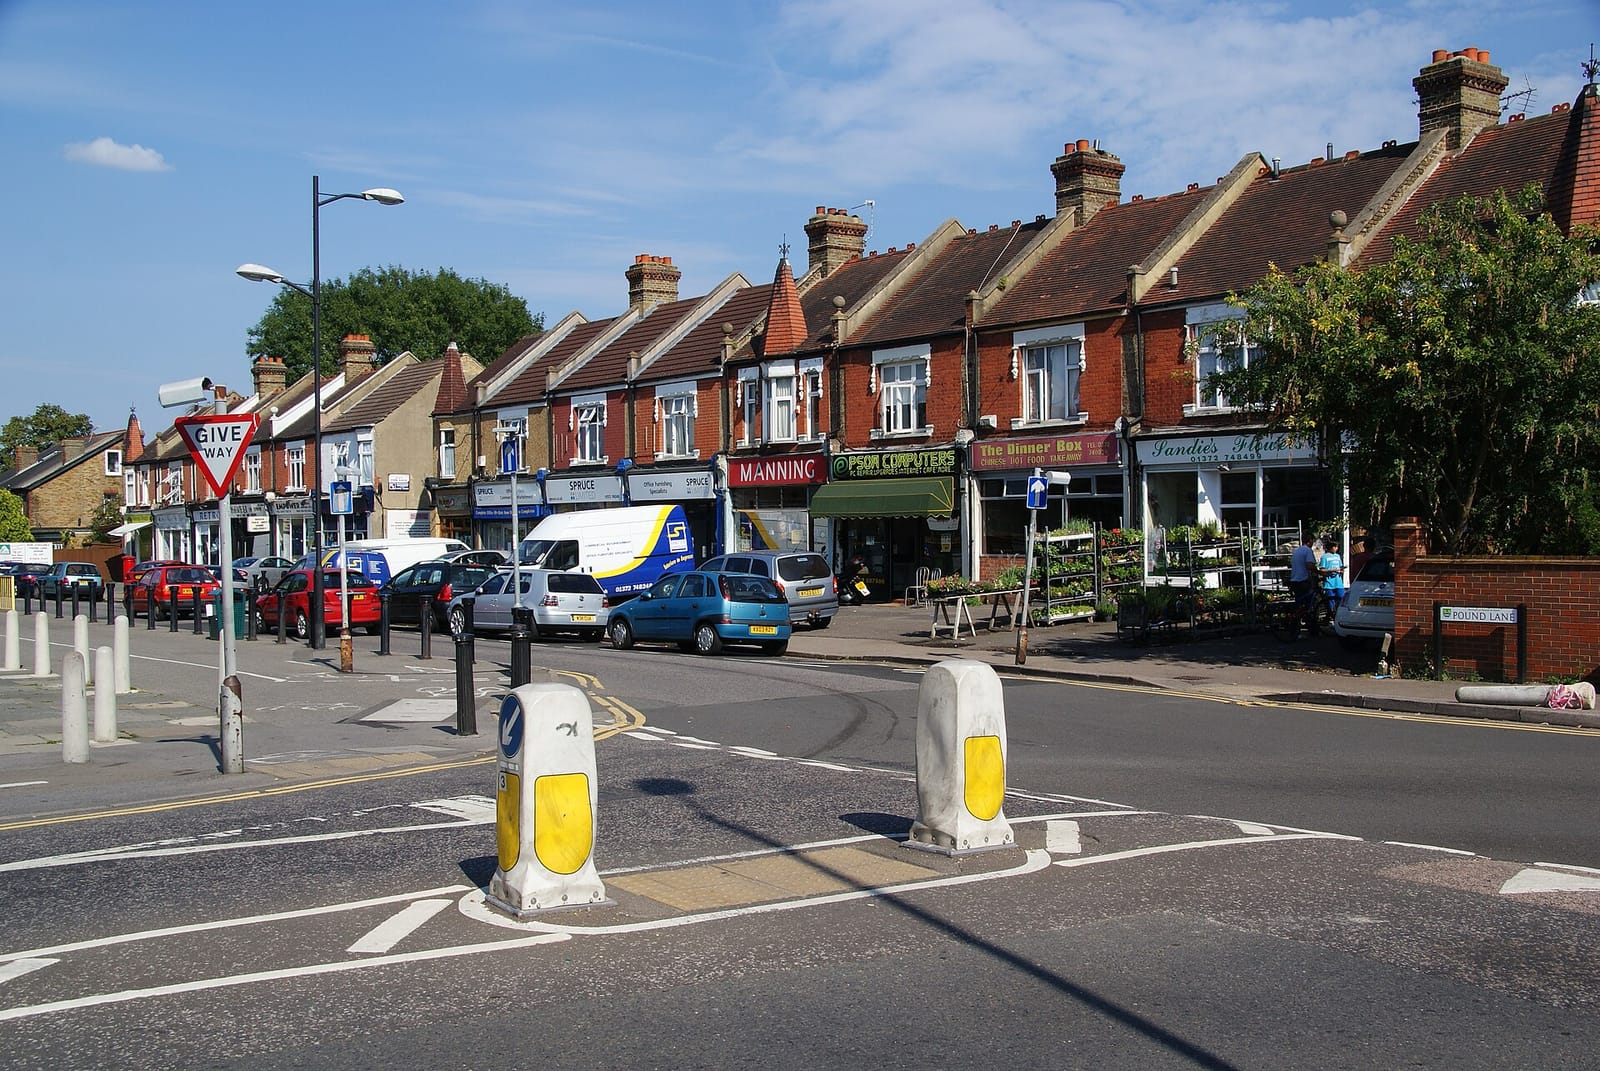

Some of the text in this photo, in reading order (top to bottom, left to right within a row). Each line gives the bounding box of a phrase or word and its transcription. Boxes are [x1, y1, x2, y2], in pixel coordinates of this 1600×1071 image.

[195, 426, 241, 443] GIVE
[204, 447, 233, 459] WAY
[980, 440, 1082, 456] The Dinner Box
[1152, 438, 1218, 457] Sandie's
[882, 450, 955, 469] COMPUTERS
[981, 453, 1082, 466] CHINESE HOT FOOD TAKEAWAY
[1224, 453, 1262, 461] 748499
[740, 459, 815, 482] MANNING
[569, 480, 596, 491] SPRUCE
[686, 477, 709, 487] SPRUCE
[477, 487, 494, 495] SPRUCE
[615, 585, 631, 593] 01372
[1453, 611, 1516, 622] POUND LANE
